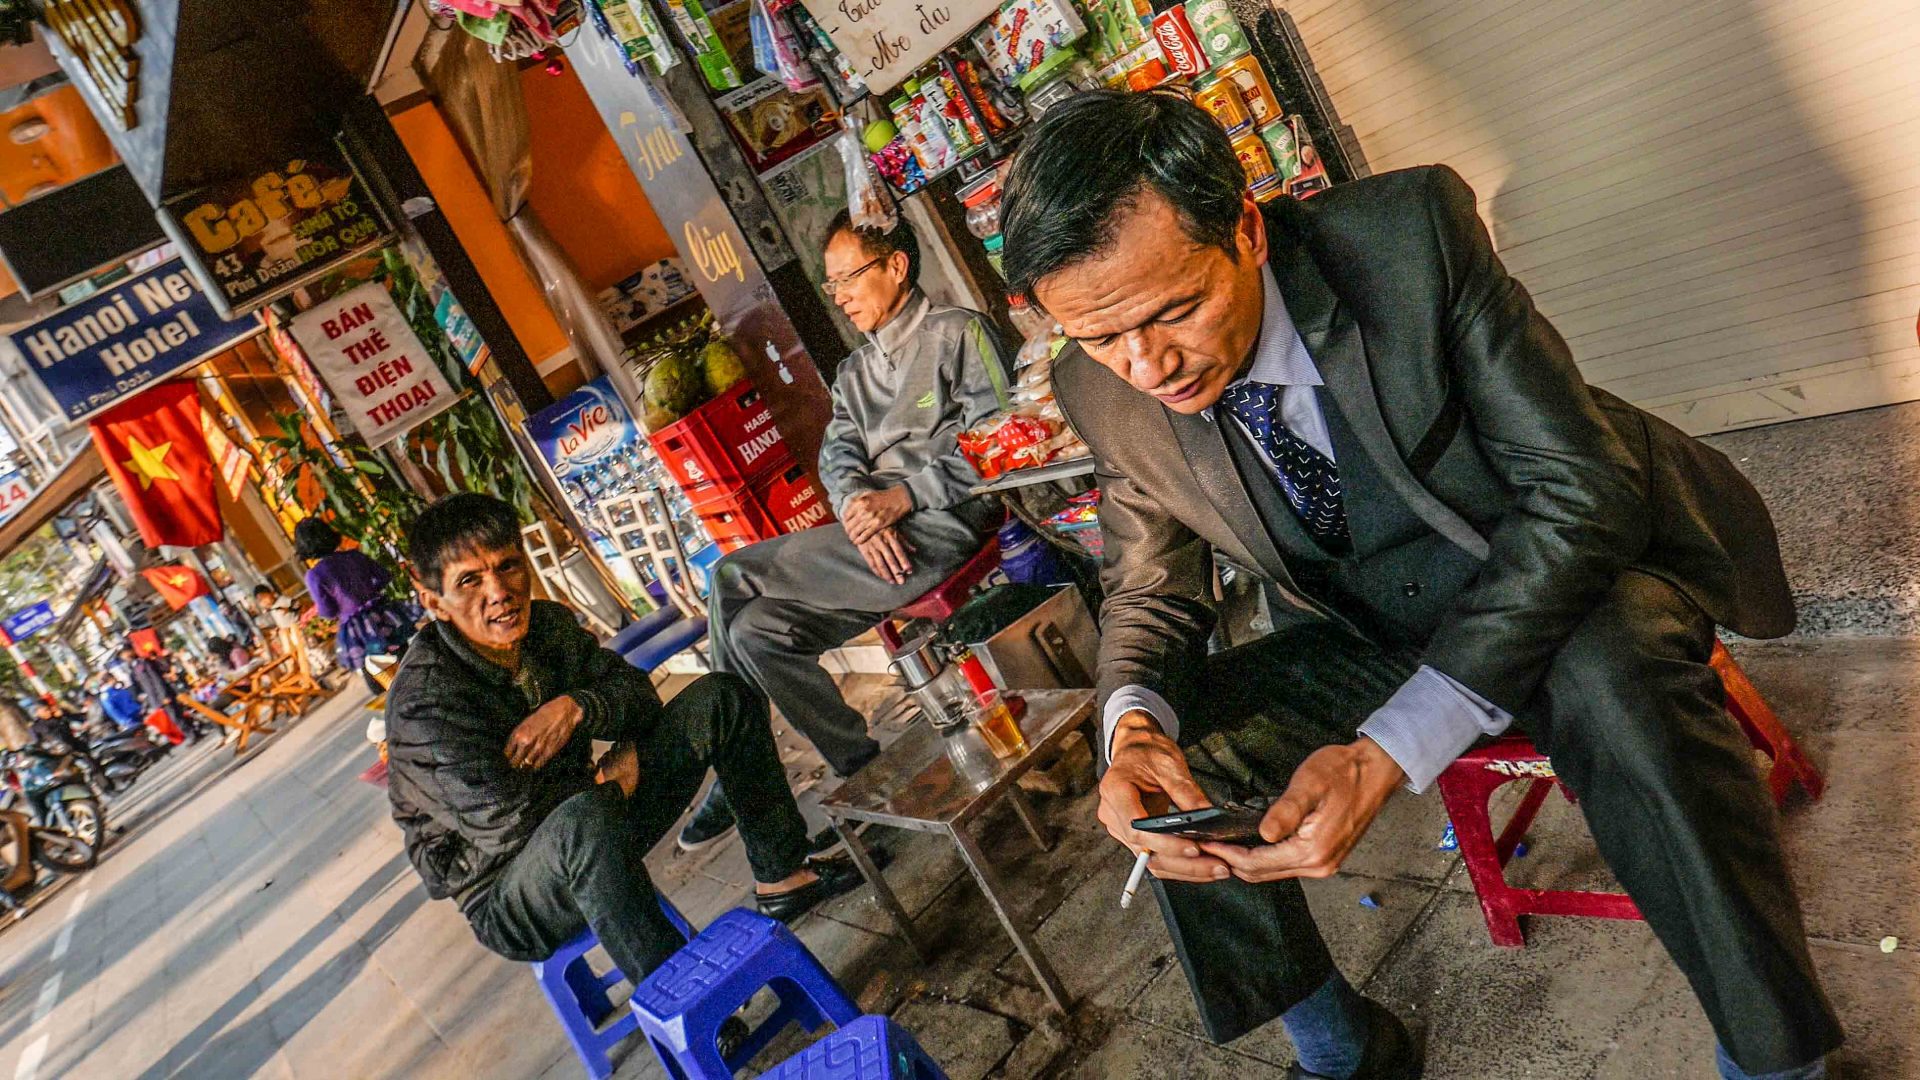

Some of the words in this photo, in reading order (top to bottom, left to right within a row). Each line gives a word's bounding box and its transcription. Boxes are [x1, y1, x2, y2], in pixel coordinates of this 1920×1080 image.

[24, 293, 140, 369] Hanoi
[320, 302, 375, 341] BÁN
[100, 310, 201, 378] Hotel
[341, 327, 391, 365] THẺ
[354, 354, 414, 398] ĐIỆN
[366, 379, 438, 427] THOẠI
[737, 424, 784, 466] HANOI
